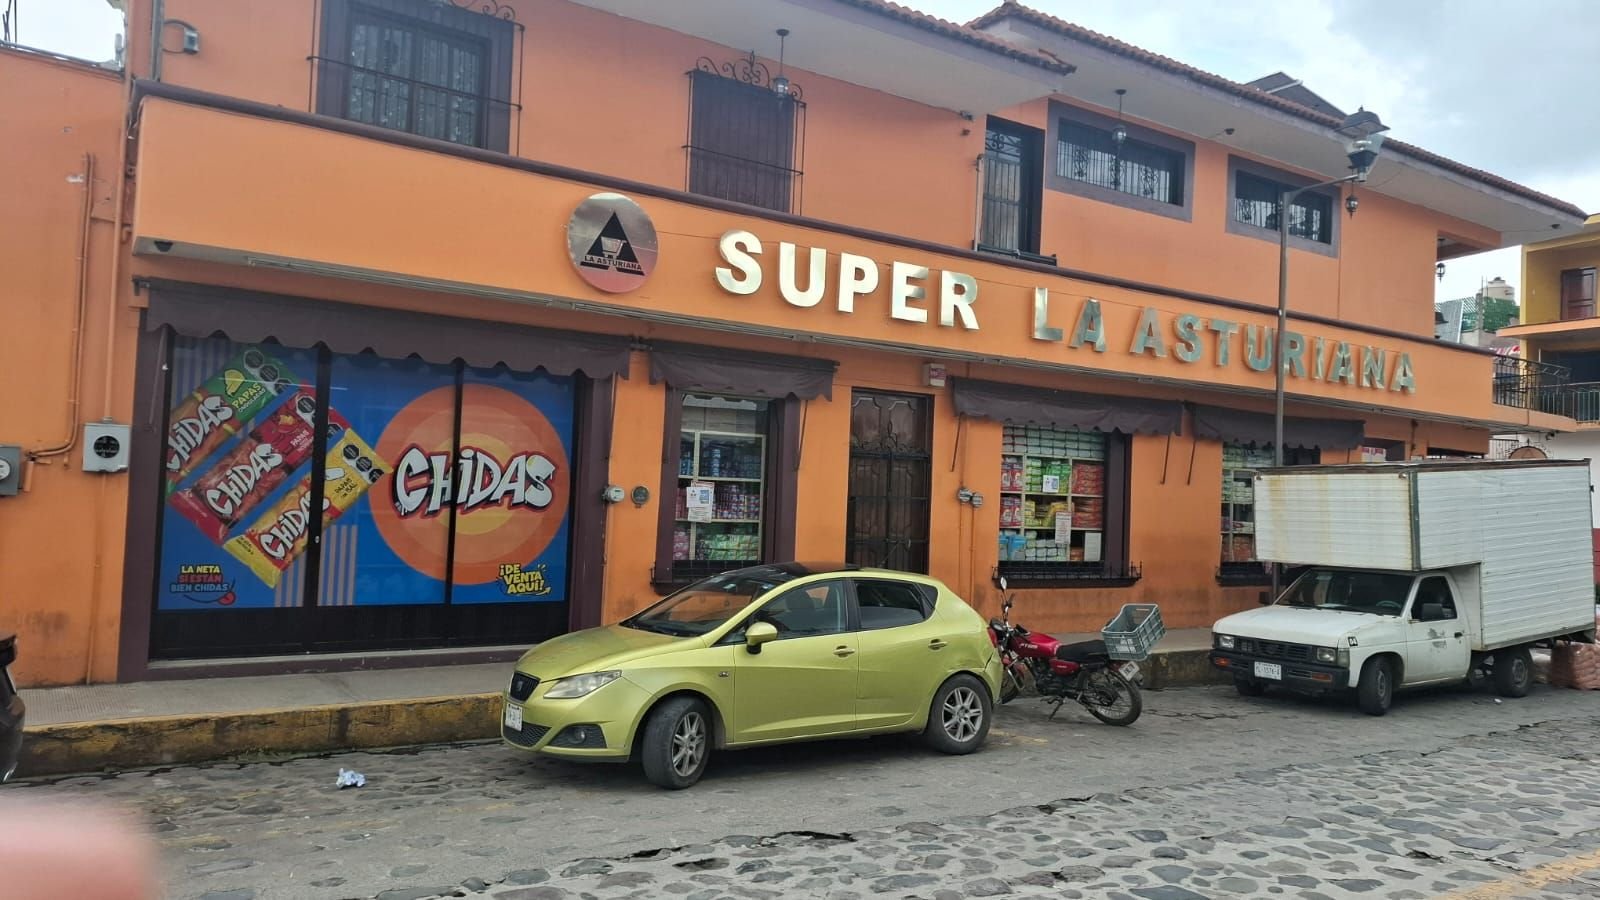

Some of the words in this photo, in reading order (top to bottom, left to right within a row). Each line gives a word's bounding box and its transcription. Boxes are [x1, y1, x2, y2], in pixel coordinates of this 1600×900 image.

[597, 257, 642, 269] ASTURIANA
[714, 229, 980, 331] SUPER
[1031, 286, 1106, 352] LA
[1130, 306, 1417, 394] ASTURIANA
[231, 383, 262, 409] PAPAS
[181, 565, 194, 574] LA
[196, 565, 220, 574] NETA
[503, 571, 542, 585] VENTA
[170, 584, 192, 592] BIEN
[194, 583, 229, 592] CHIDAS
